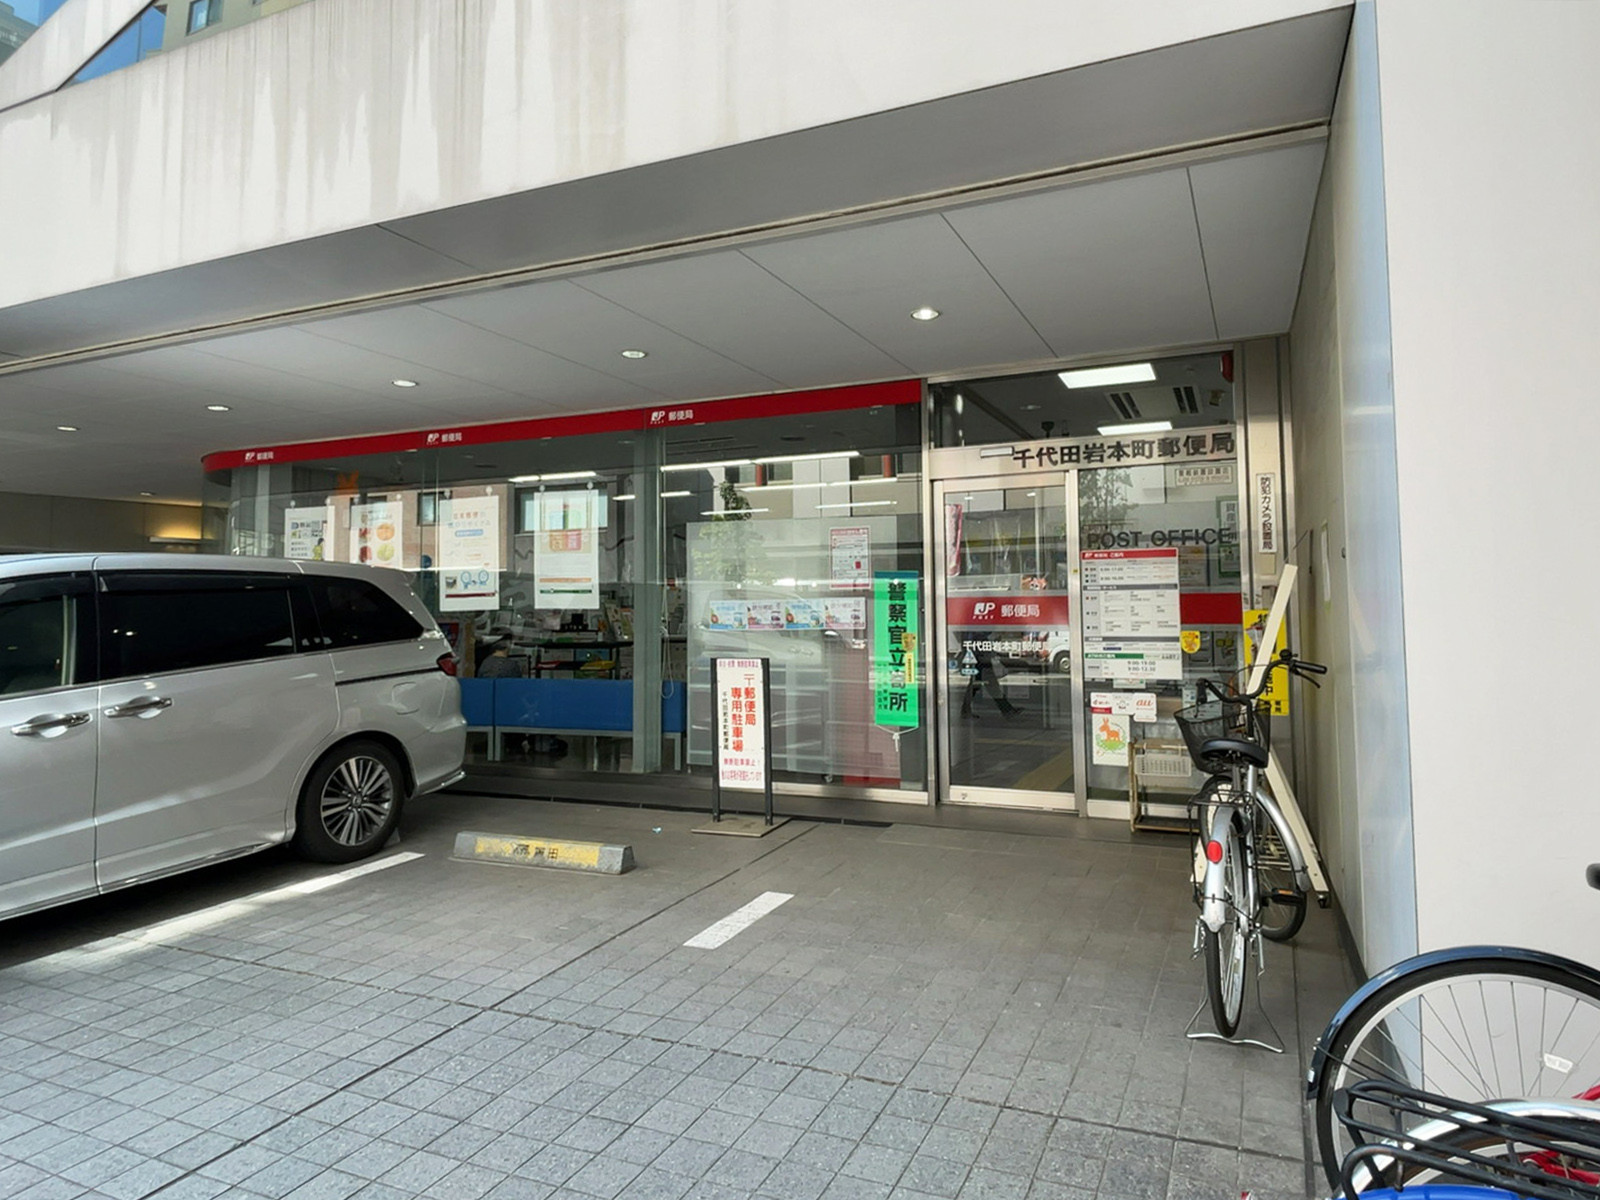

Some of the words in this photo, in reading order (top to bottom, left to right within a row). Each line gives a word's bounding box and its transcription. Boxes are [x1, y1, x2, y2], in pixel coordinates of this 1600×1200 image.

[668, 409, 694, 421] 郵便局
[1013, 432, 1235, 468] 千代田岩本町郵便局
[1087, 530, 1142, 549] POST
[1151, 527, 1233, 547] OFFICE
[1001, 604, 1040, 618] 郵便局
[731, 687, 744, 753] 専用駐車場
